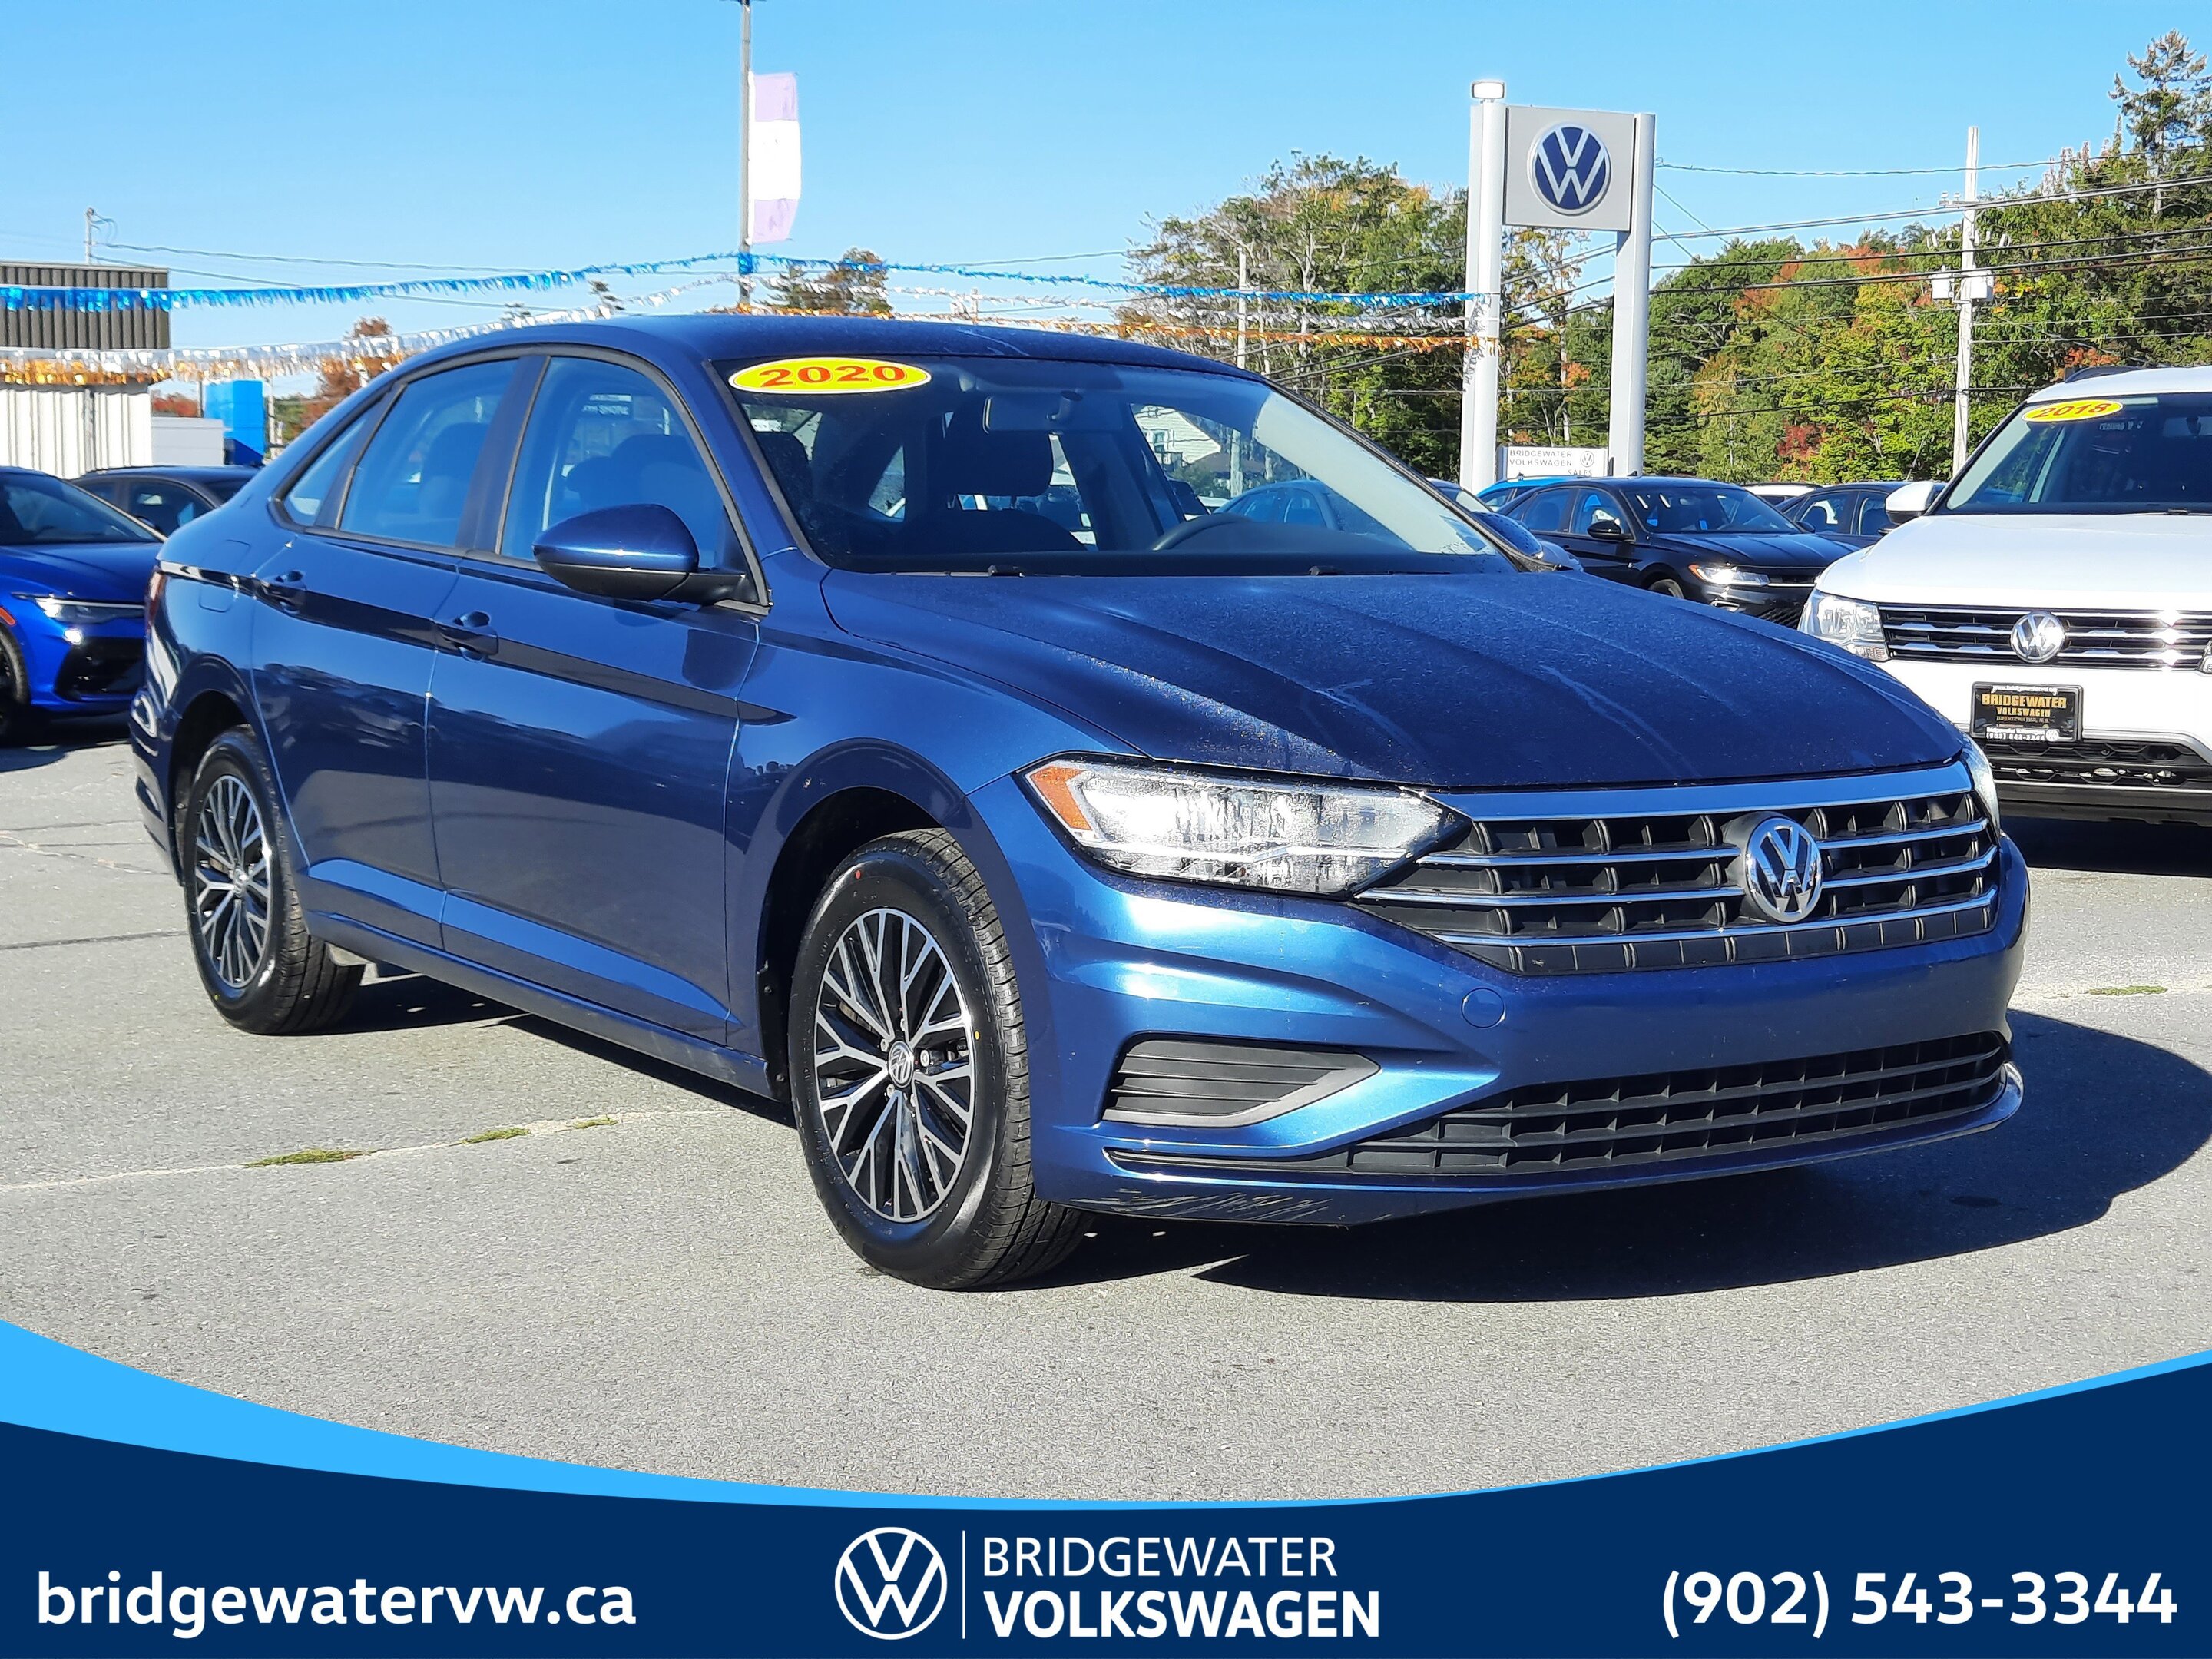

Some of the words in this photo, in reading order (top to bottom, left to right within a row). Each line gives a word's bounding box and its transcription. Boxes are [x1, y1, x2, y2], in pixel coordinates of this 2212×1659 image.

[759, 365, 908, 387] 2020
[2032, 402, 2114, 419] 2018
[1982, 694, 2067, 708] BRIDGEWATER
[1996, 707, 2051, 717] VOLKSWAGEN
